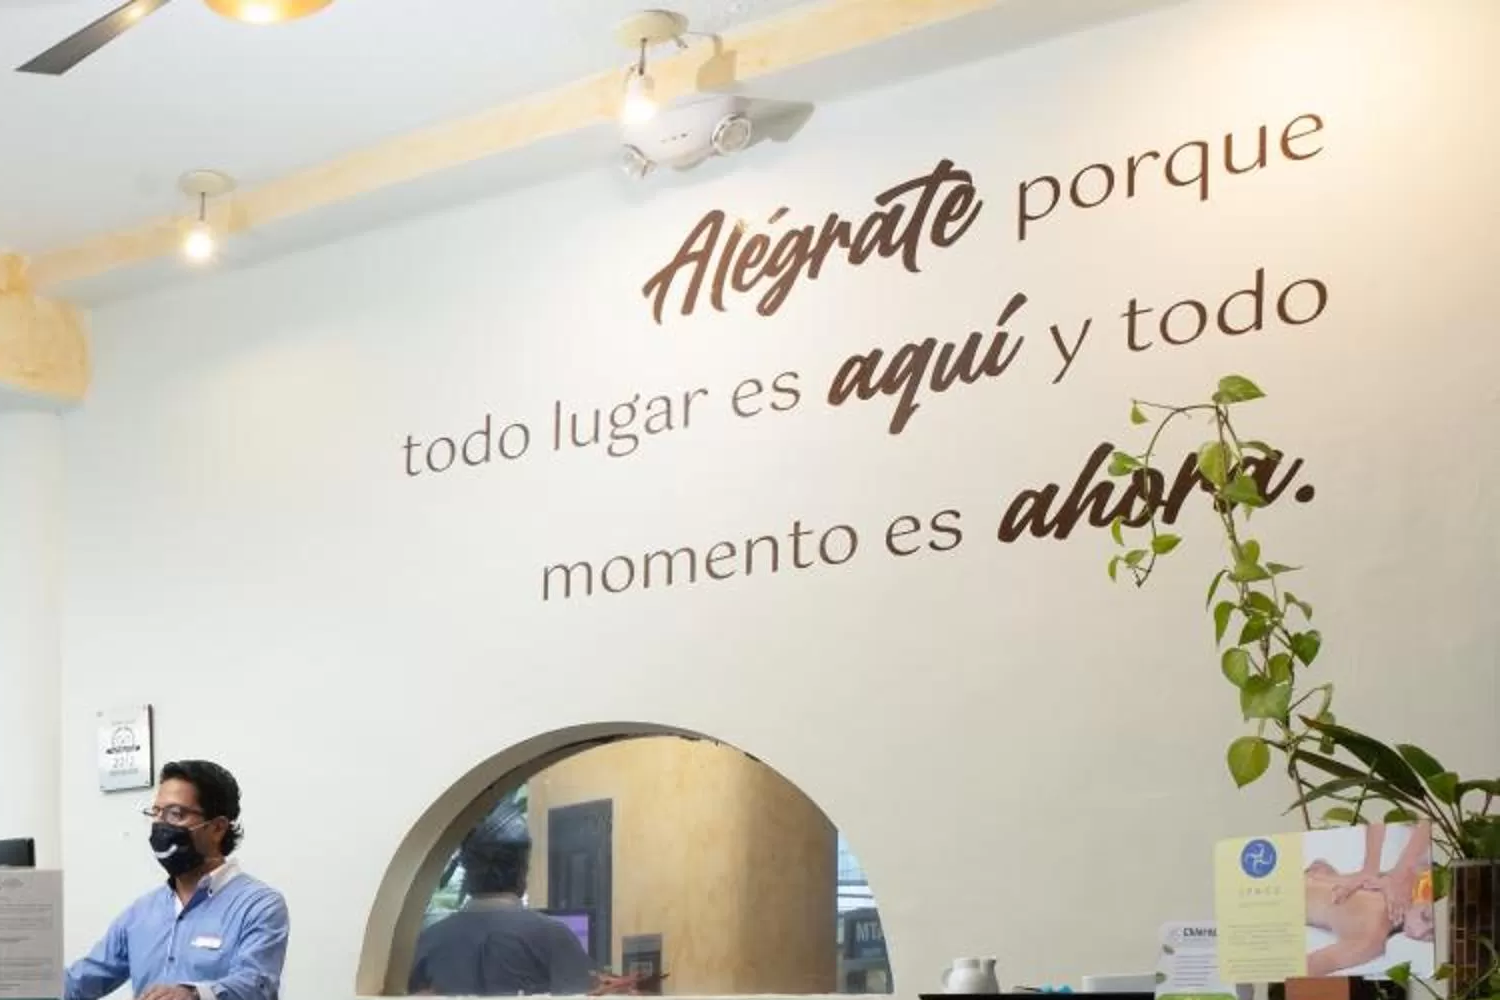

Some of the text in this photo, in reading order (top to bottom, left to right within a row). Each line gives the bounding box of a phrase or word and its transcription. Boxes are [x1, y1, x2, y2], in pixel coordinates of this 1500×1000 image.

[642, 114, 1324, 325] Alégrate porque
[403, 267, 1329, 476] todo lugar es aquí y todo
[542, 520, 859, 601] momento
[885, 509, 963, 557] es
